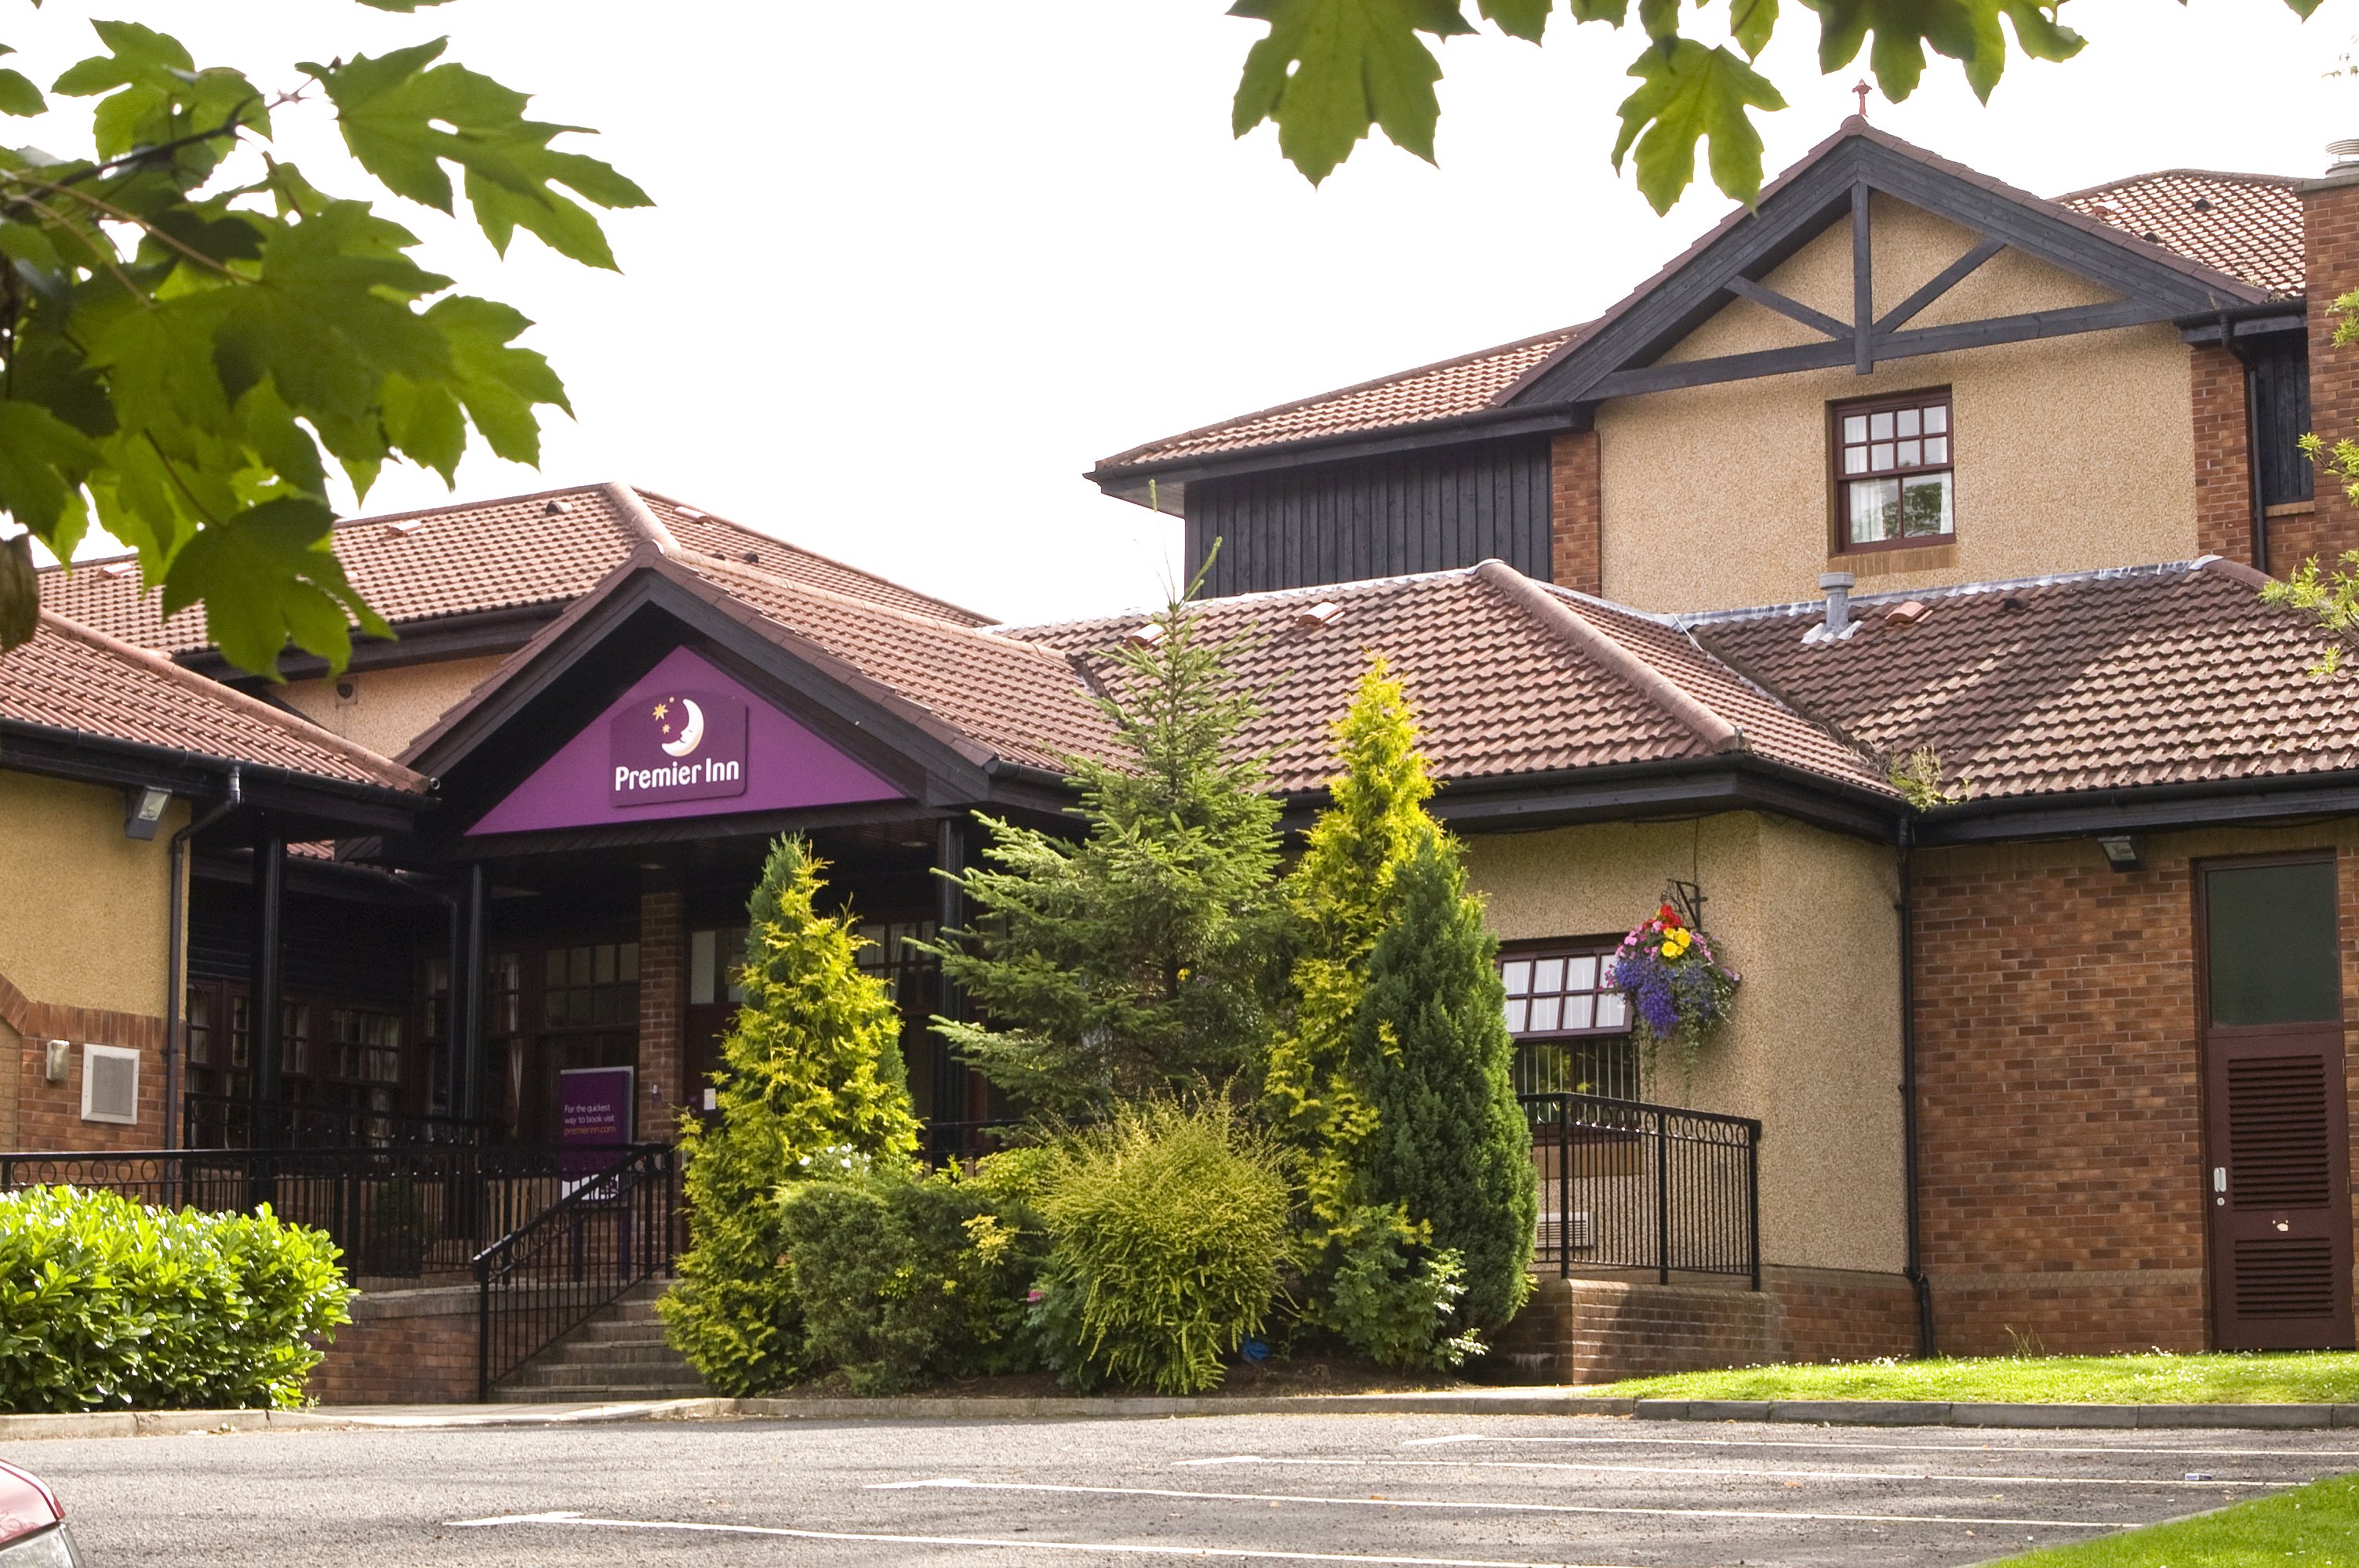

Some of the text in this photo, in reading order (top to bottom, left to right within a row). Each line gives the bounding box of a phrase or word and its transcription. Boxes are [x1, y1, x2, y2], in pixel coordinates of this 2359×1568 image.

[615, 757, 740, 791] Premier Inn
[565, 1103, 611, 1113] For the quickest
[586, 1115, 602, 1123] book
